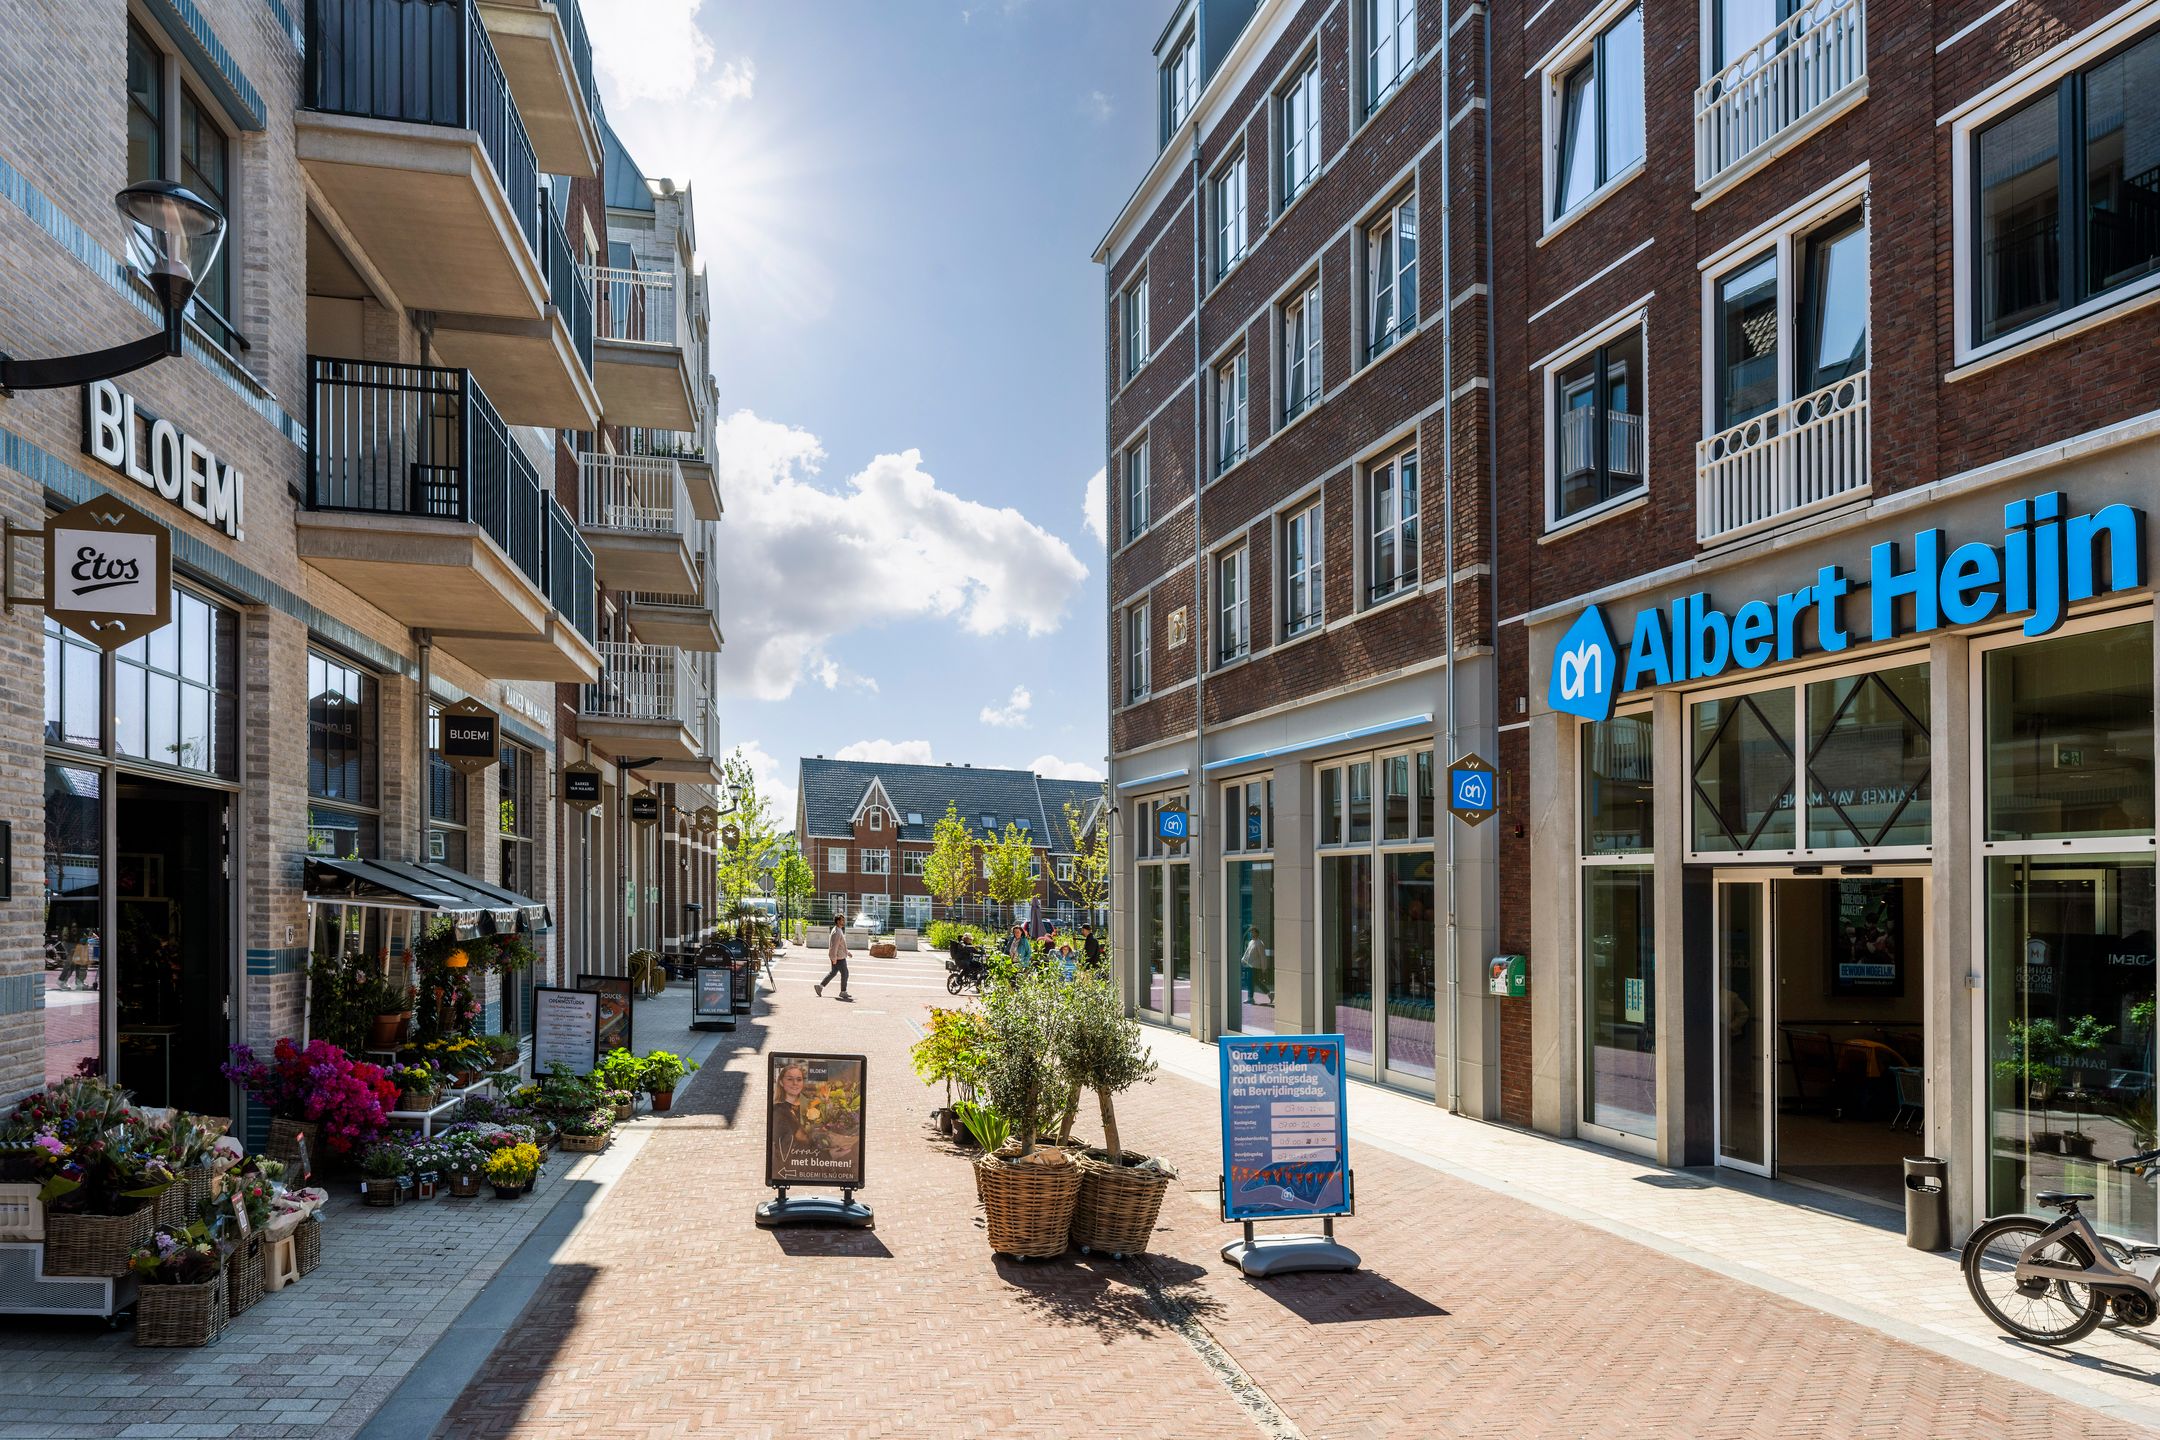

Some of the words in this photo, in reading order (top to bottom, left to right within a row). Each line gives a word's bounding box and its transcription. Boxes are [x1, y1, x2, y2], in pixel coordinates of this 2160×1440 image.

[87, 379, 244, 542] BLOEM!
[71, 546, 139, 581] Etos
[1622, 565, 1850, 692] Albert
[1871, 491, 2143, 638] Heijn
[450, 729, 489, 741] BLOEM!
[1841, 894, 1867, 905] VRIENDEN
[1232, 1049, 1259, 1060] Onze
[1232, 1061, 1307, 1074] openingstijden
[1232, 1073, 1257, 1085] rond
[1259, 1074, 1319, 1086] Koningsdag
[1232, 1087, 1246, 1096] en
[1248, 1085, 1327, 1098] Bevrijdingsdag.
[791, 1158, 808, 1166] met
[810, 1158, 852, 1168] bloemen!
